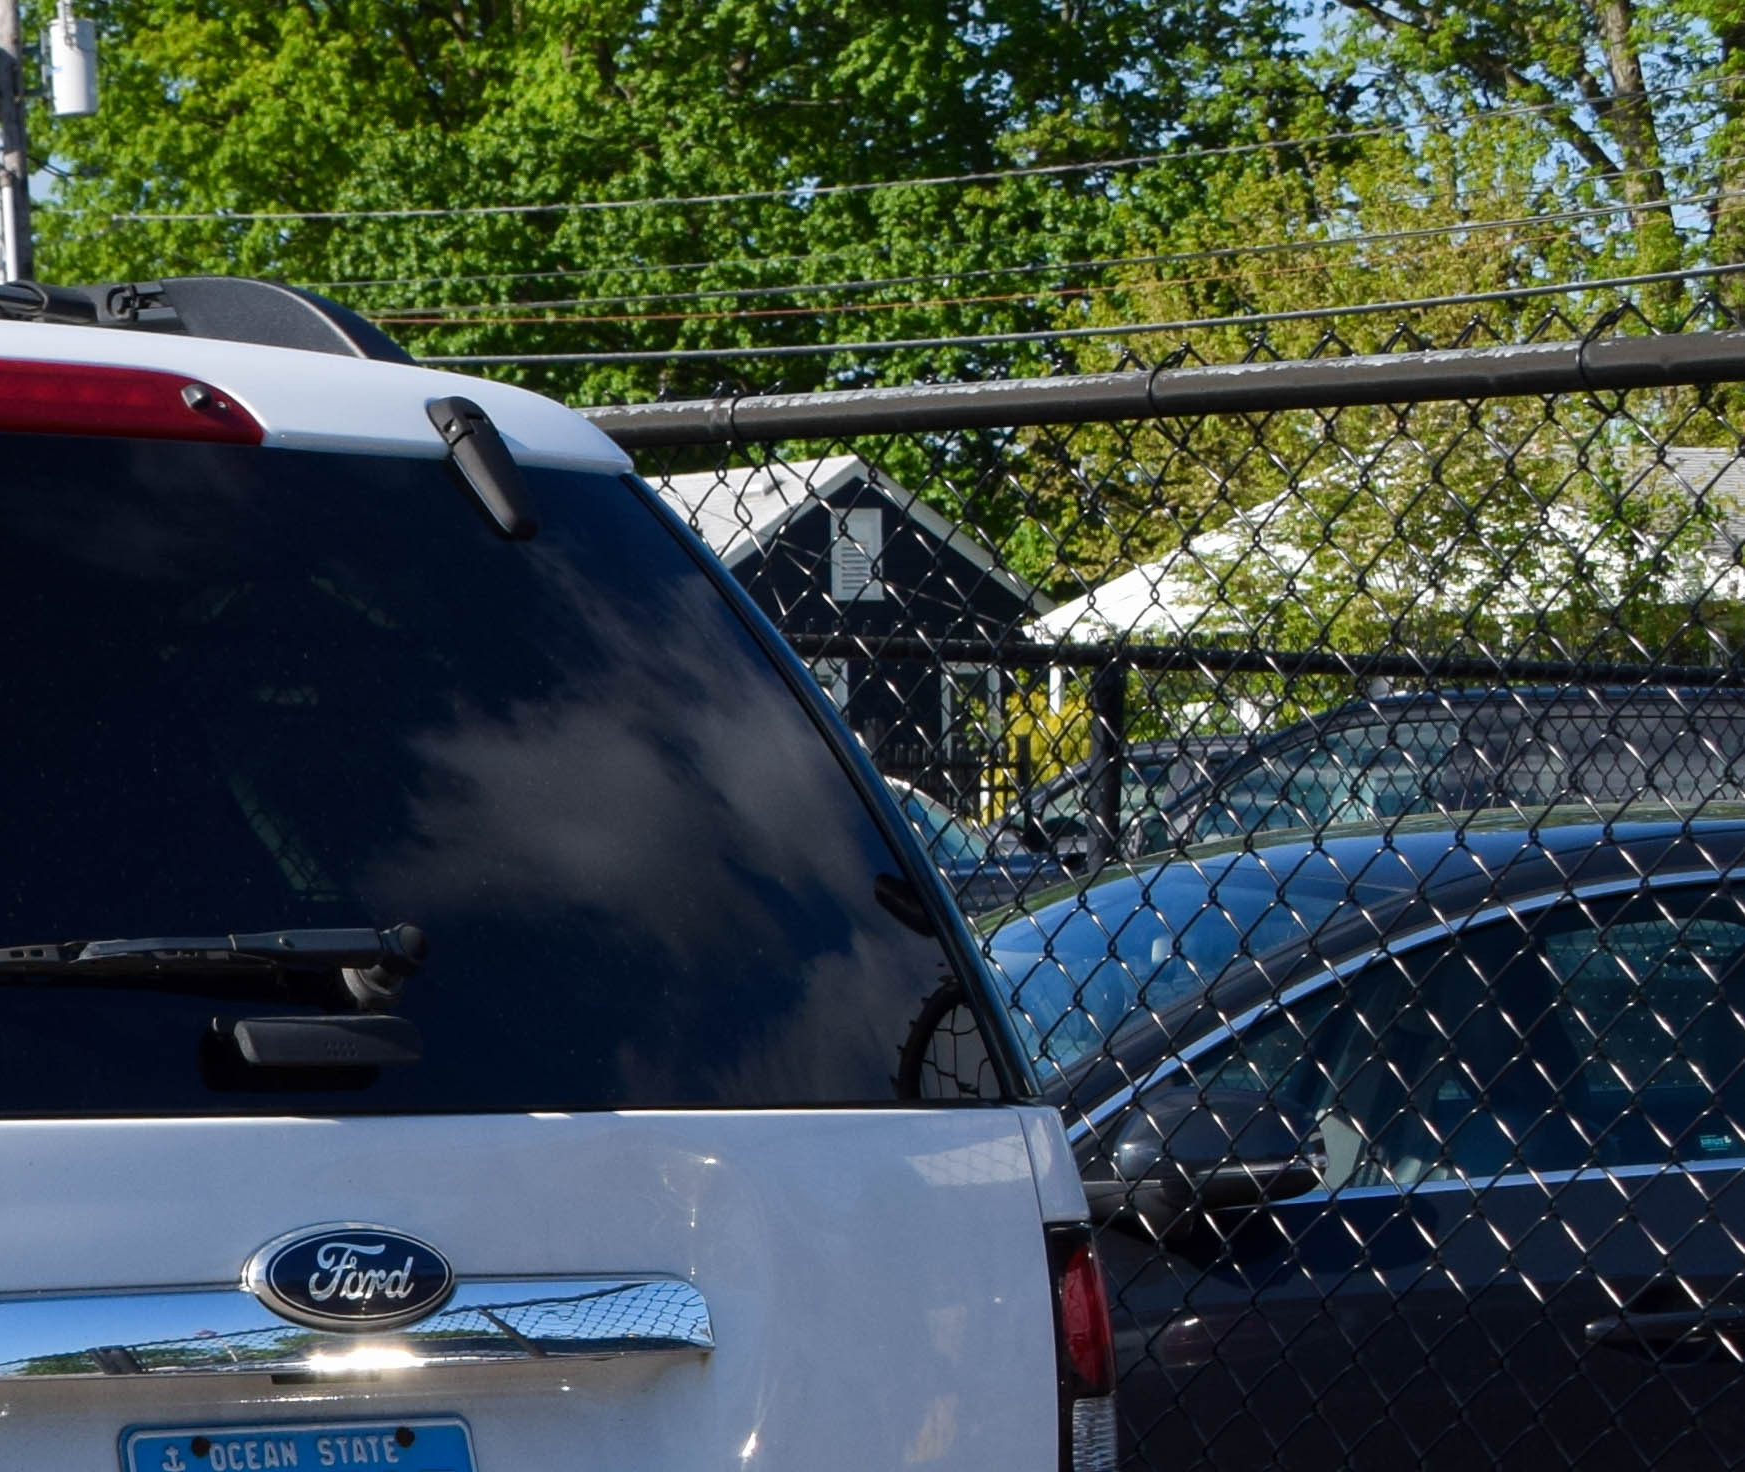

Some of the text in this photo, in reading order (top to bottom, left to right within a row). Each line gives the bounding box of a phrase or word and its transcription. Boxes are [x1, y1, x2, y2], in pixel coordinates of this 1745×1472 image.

[309, 1242, 415, 1301] Ford
[210, 1436, 400, 1472] OCEAN STATE
